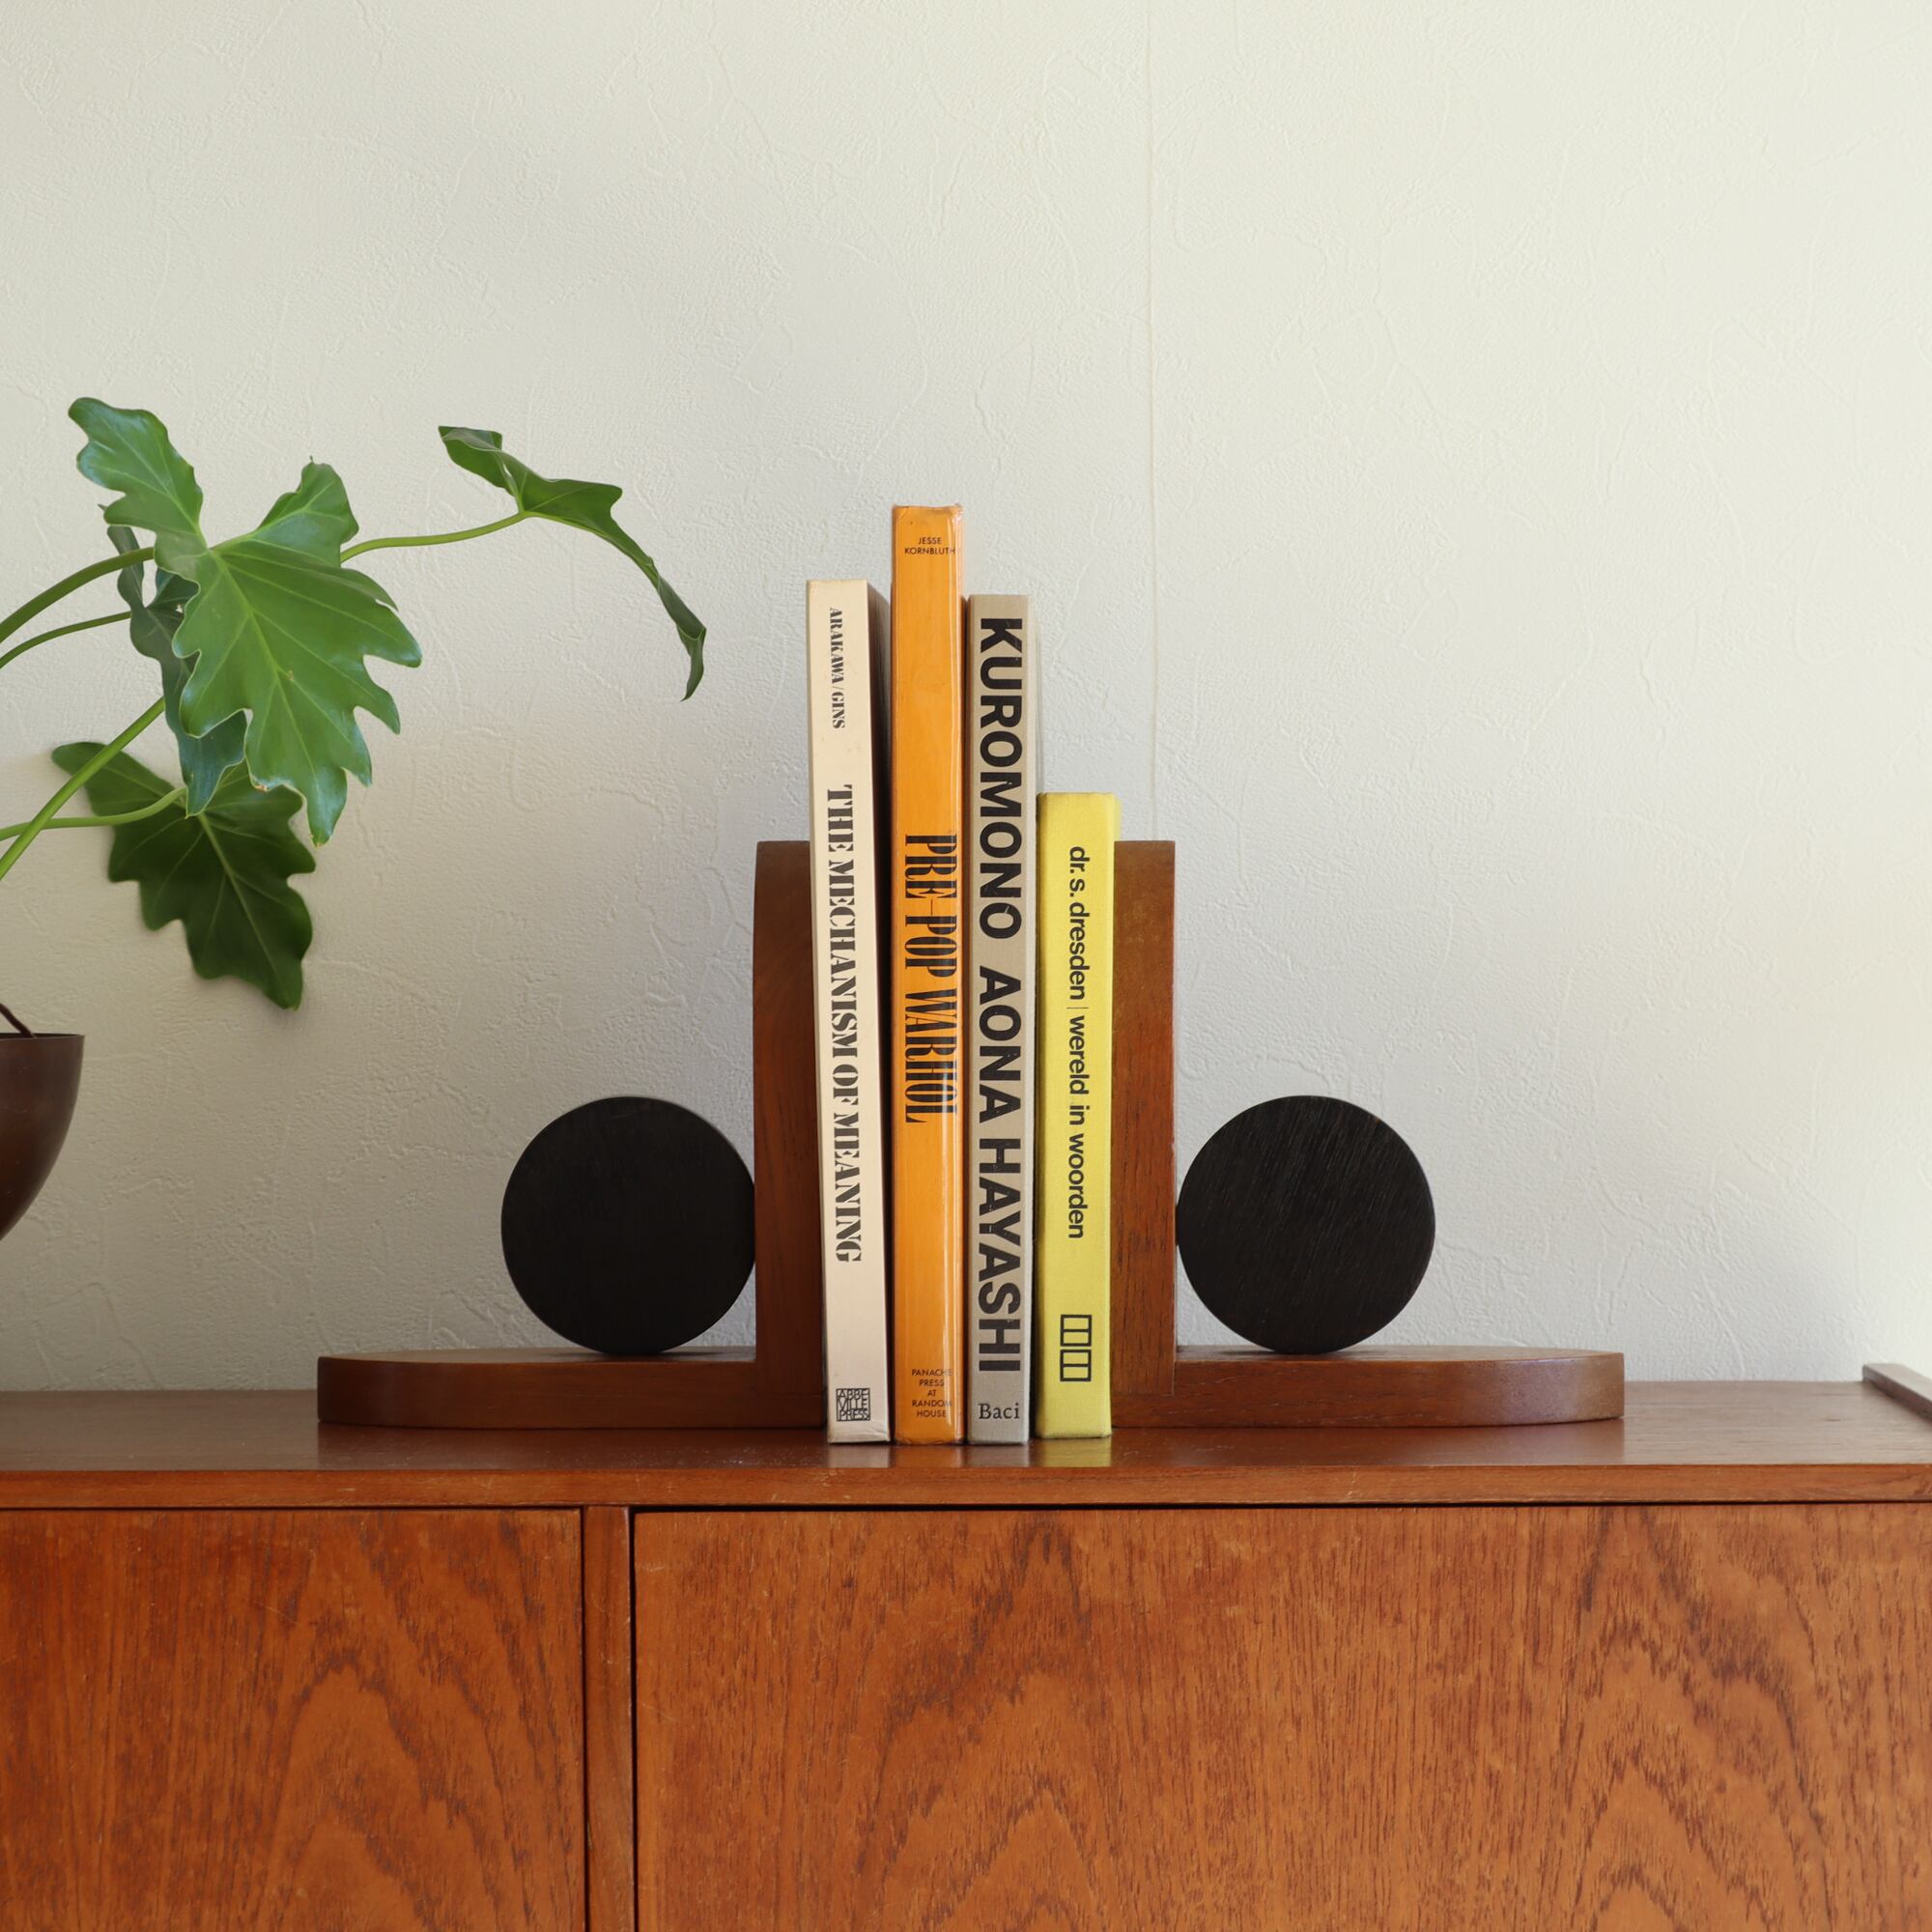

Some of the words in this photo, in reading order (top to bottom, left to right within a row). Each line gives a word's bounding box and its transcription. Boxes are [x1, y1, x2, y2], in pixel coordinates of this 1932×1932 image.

[904, 547, 956, 555] KORNBLUTH
[918, 537, 942, 545] JESSE
[980, 618, 1023, 939] KUROMONO
[827, 783, 853, 852] THE
[1069, 846, 1090, 874] dr.
[1069, 878, 1085, 897] s.
[904, 835, 957, 978] PRE-POP
[828, 859, 858, 1058] MECHANISM
[1069, 902, 1090, 1000] dresden
[904, 988, 957, 1123] WARHOL
[979, 966, 1022, 1123] AONA
[1068, 1015, 1090, 1095] wereld
[832, 1064, 859, 1106] OF
[1069, 1105, 1090, 1125] in
[834, 1112, 862, 1263] MEANING
[1068, 1133, 1088, 1238] woorden
[978, 1138, 1021, 1371] HAYASHI
[911, 1368, 952, 1377] PANACHE
[919, 1378, 945, 1387] PRESS
[911, 1399, 952, 1407] RANDOM
[916, 1410, 948, 1418] HOUSE
[978, 1403, 1020, 1420] Baci
